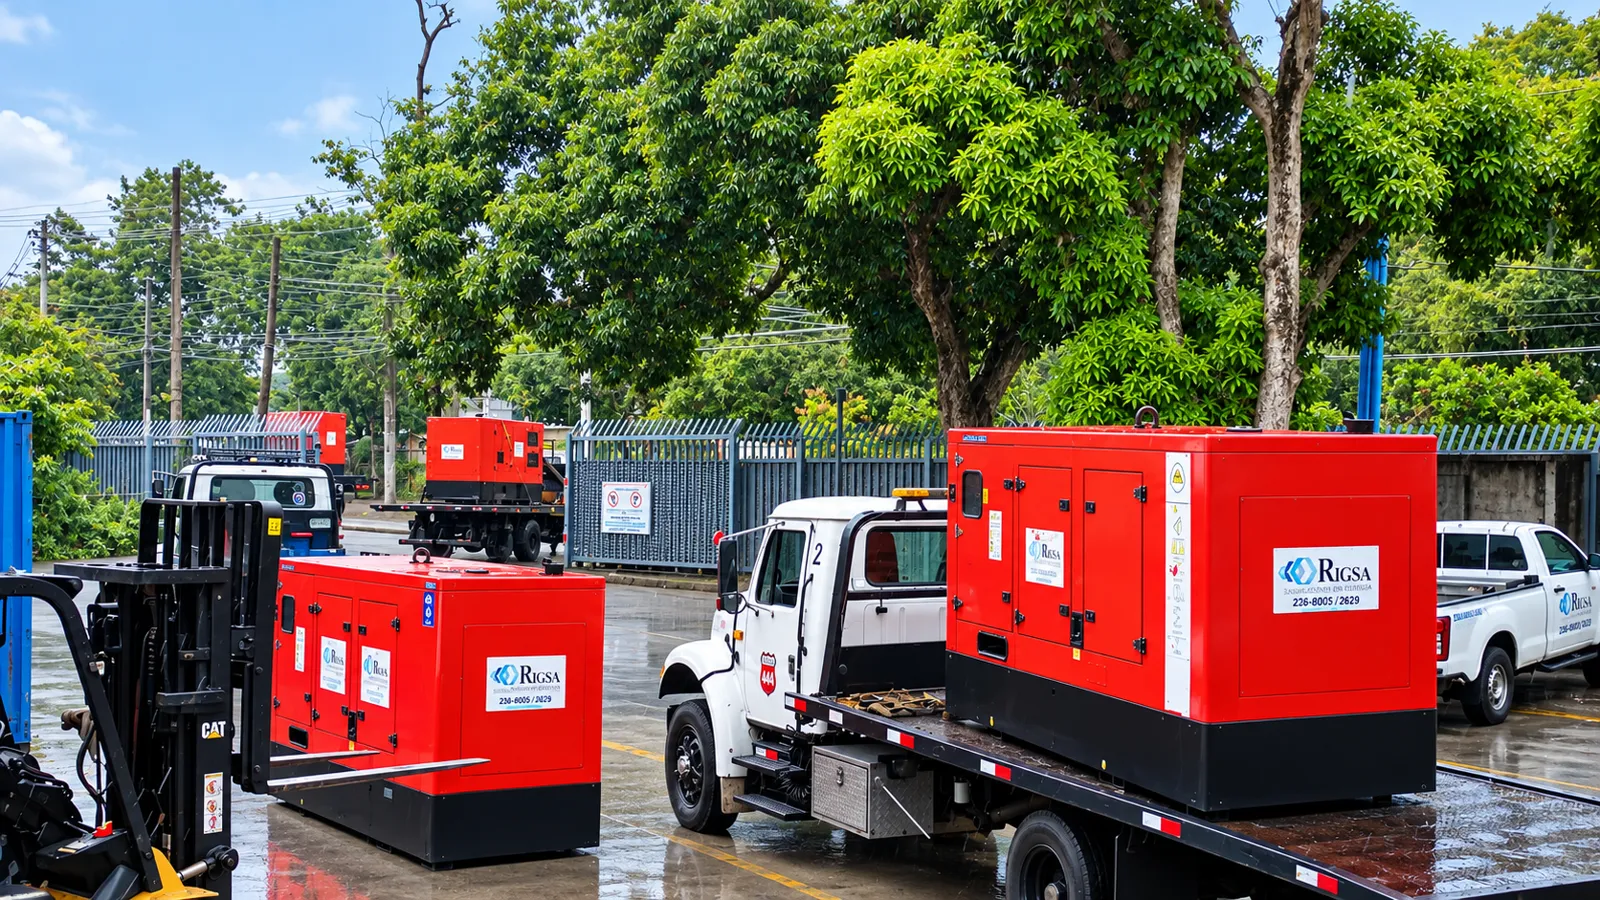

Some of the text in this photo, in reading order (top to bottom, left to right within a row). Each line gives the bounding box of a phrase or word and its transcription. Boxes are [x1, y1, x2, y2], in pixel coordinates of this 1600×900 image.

[812, 543, 823, 566] 2
[1318, 558, 1372, 583] RIGSA
[520, 664, 561, 685] RIGSA
[761, 670, 775, 687] 444
[201, 720, 227, 739] CAT
